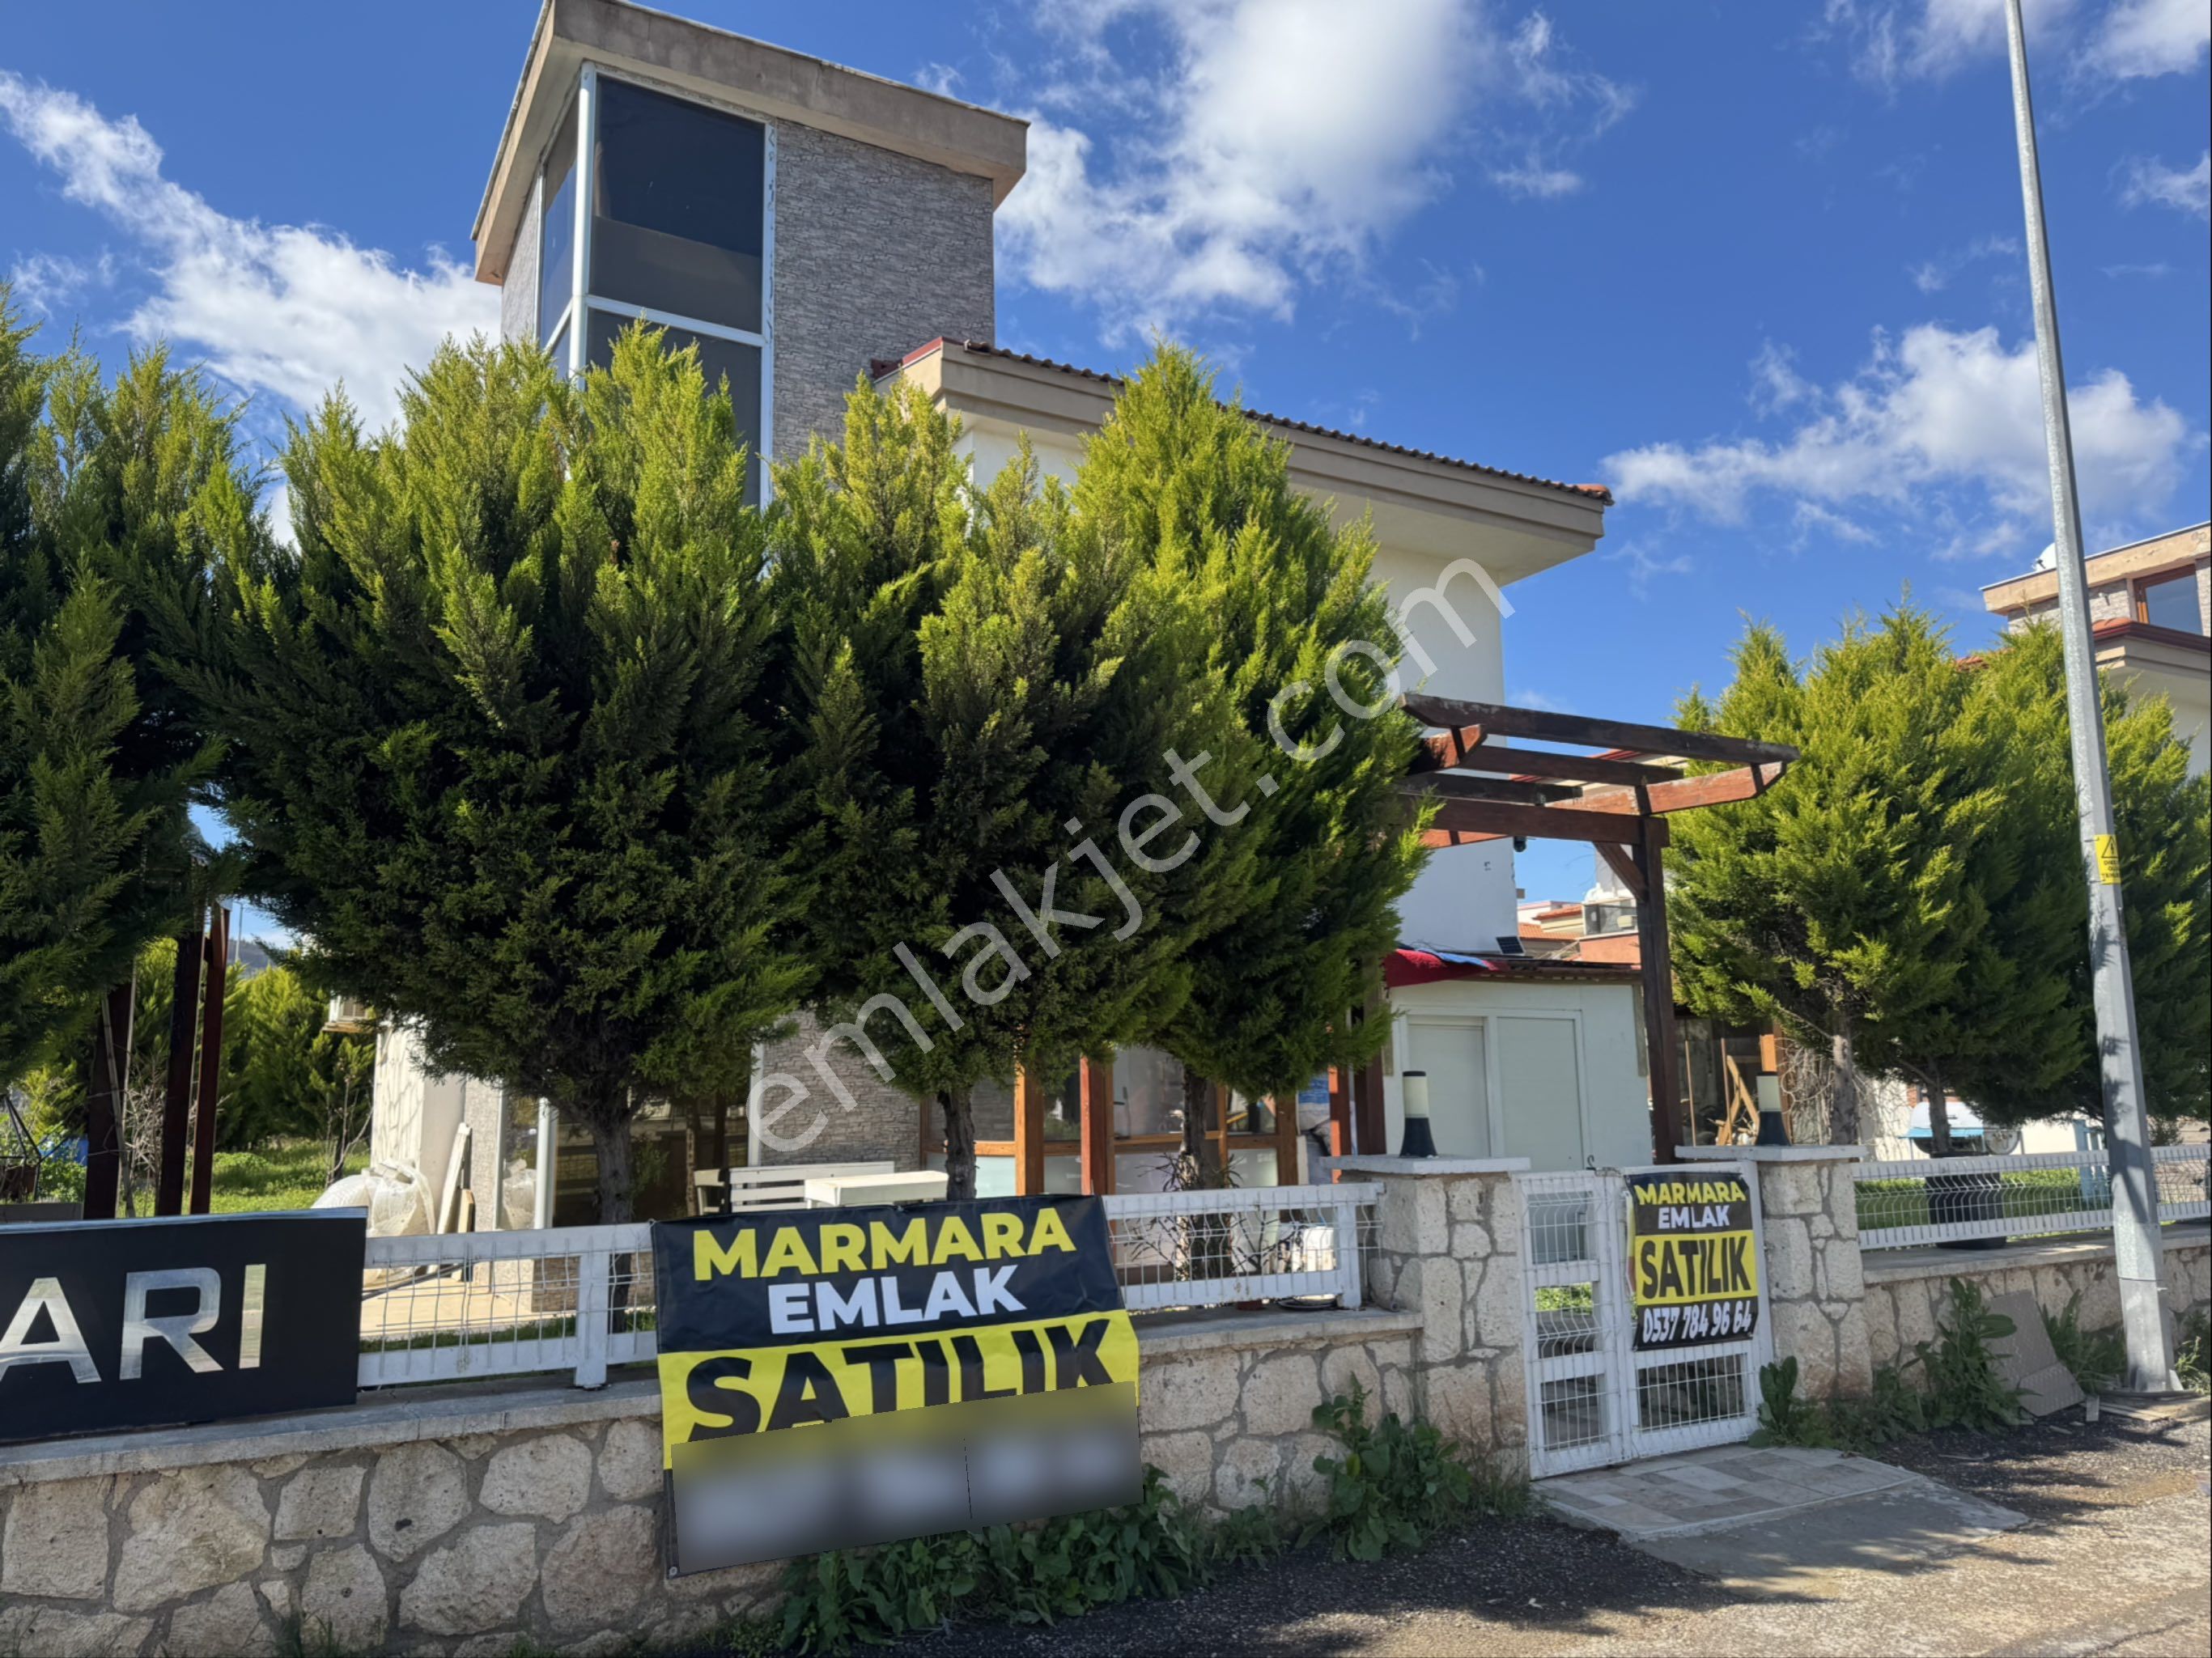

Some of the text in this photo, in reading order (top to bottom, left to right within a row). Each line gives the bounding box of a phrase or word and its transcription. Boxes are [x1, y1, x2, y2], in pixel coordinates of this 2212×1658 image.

[1634, 1181, 1746, 1205] MARMARA
[1658, 1205, 1730, 1229] EMLAK
[693, 1207, 1076, 1281] MARMARA
[1641, 1236, 1751, 1299] SATILIK
[768, 1265, 1026, 1334] EMLAK
[1643, 1300, 1751, 1343] 0537 784 96 64
[686, 1319, 1114, 1442] SATILIK
